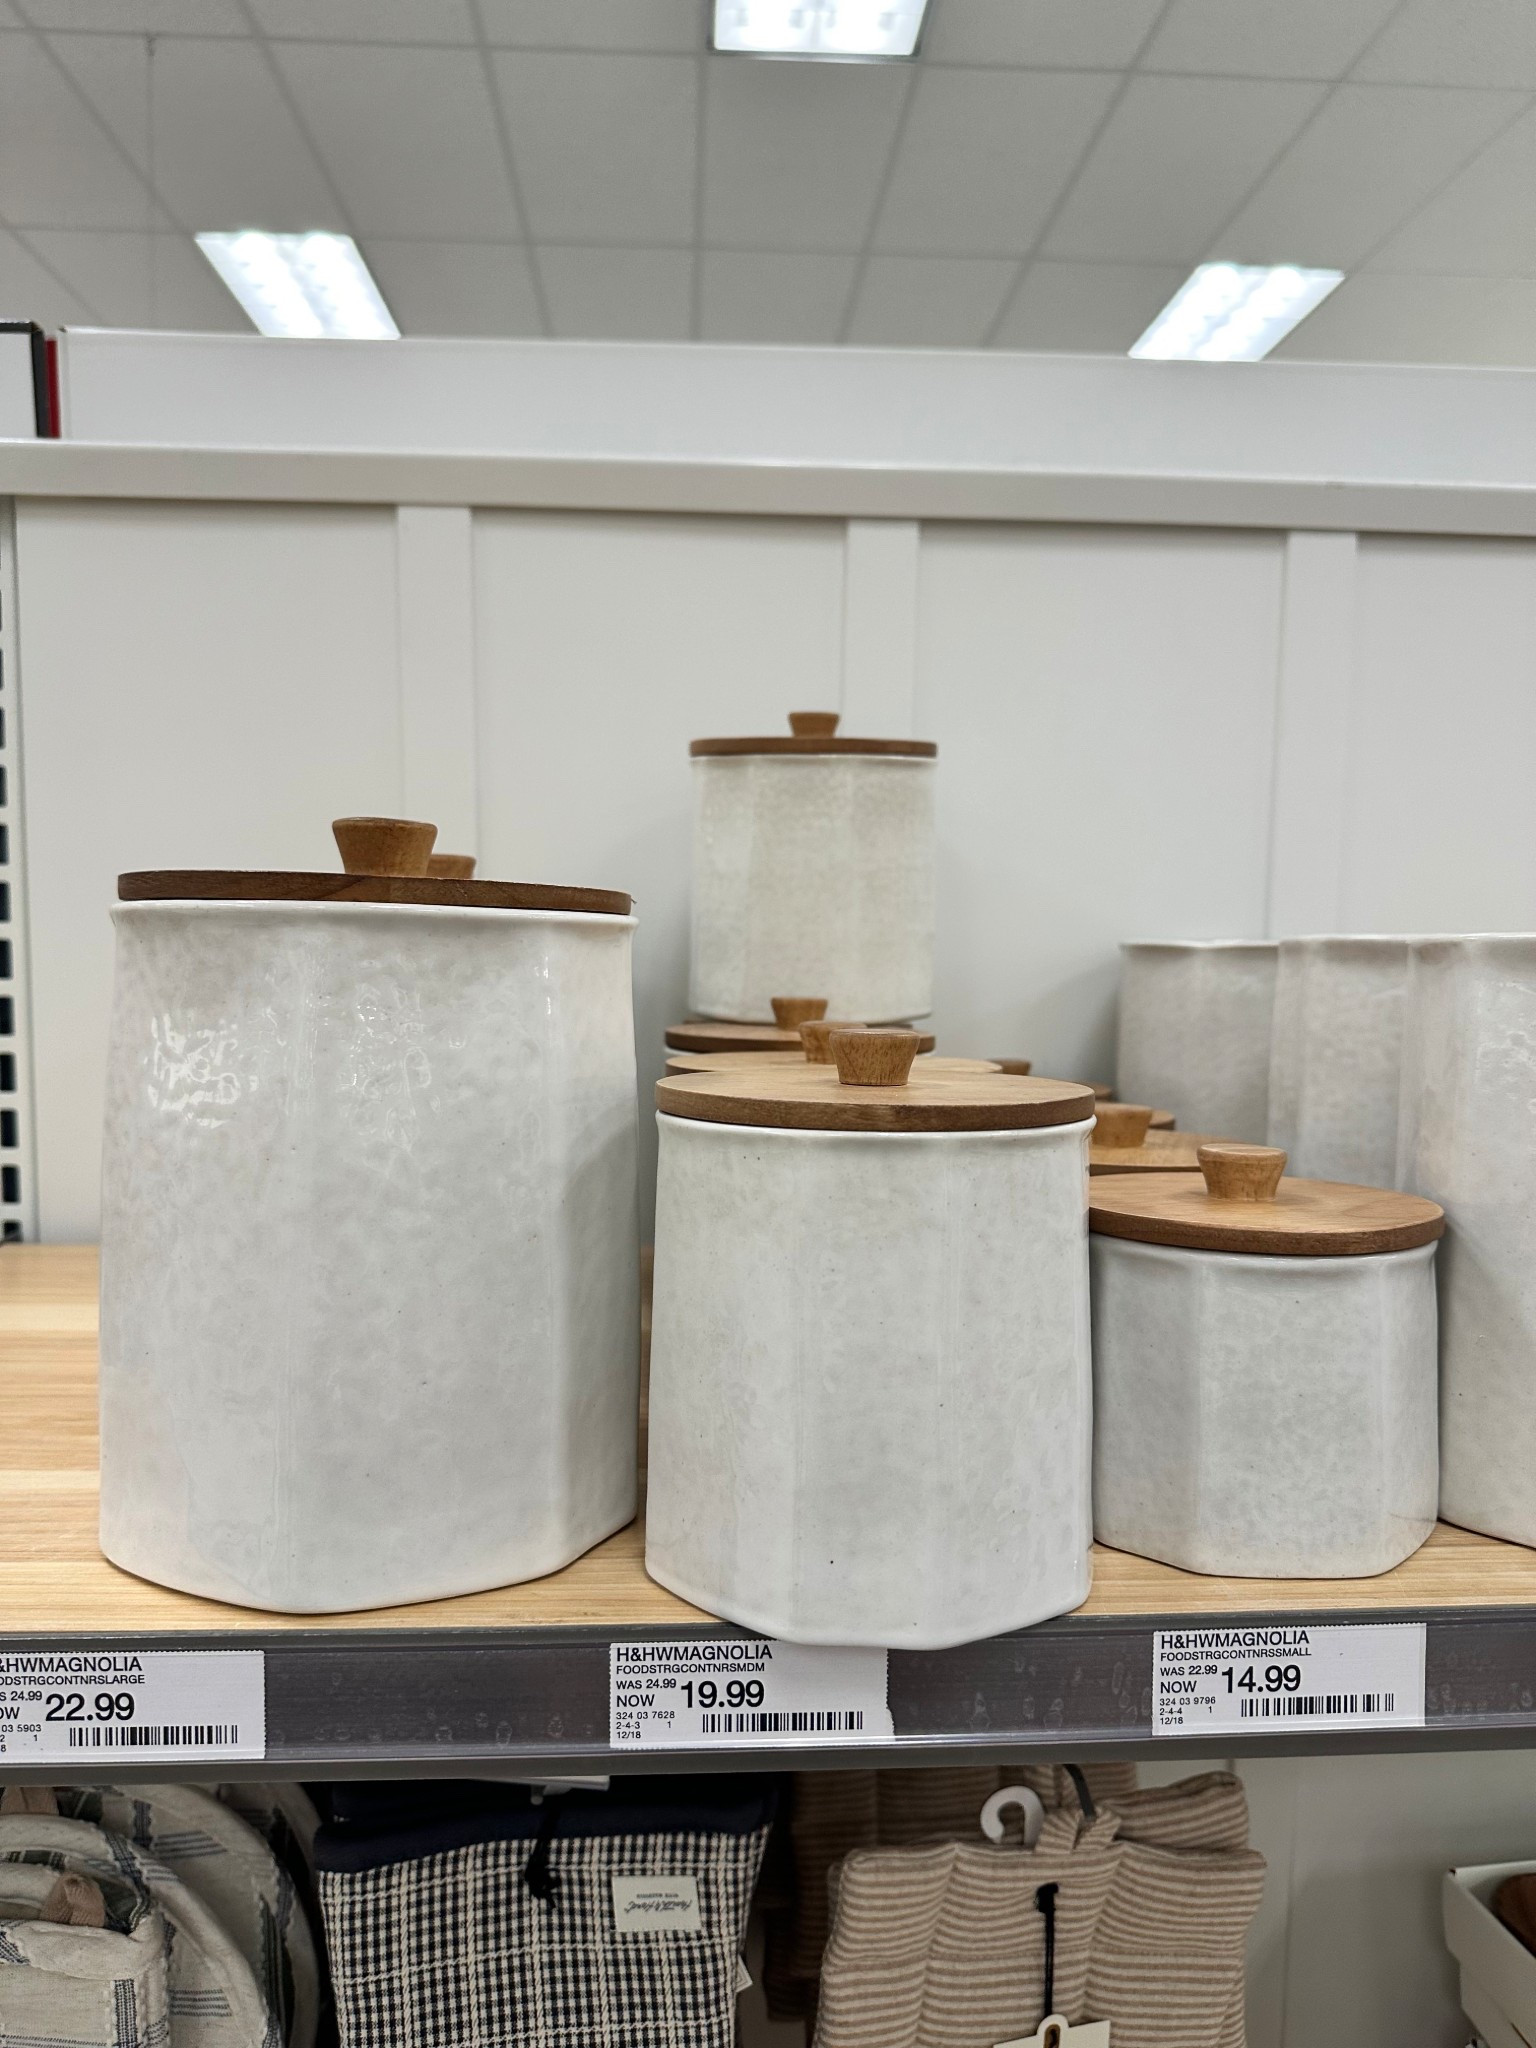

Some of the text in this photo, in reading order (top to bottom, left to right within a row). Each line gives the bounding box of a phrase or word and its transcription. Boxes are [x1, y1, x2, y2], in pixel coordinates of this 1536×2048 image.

[1161, 1630, 1309, 1649] H&HWMAGNOLIA
[617, 1646, 772, 1661] H&HWMAGNOLIA
[1161, 1648, 1311, 1661] FOODSTRGCONTNRSSMALL
[617, 1662, 764, 1674] FOODSTRGCONTNRSMDM
[1160, 1665, 1217, 1676] WAS 22.99
[616, 1678, 676, 1689] WAS 24.99
[1161, 1665, 1300, 1694] NOW 14.99
[11, 1691, 42, 1701] 24.99
[617, 1680, 764, 1708] NOW 19.99
[1160, 1696, 1215, 1706] 324 03 9796
[46, 1693, 134, 1721] 22.99
[1160, 1707, 1182, 1715] 2-4-4
[652, 1711, 675, 1719] 7628
[17, 1724, 41, 1732] 5903
[616, 1721, 640, 1729] 2-4-3
[617, 1731, 641, 1739] 12/18
